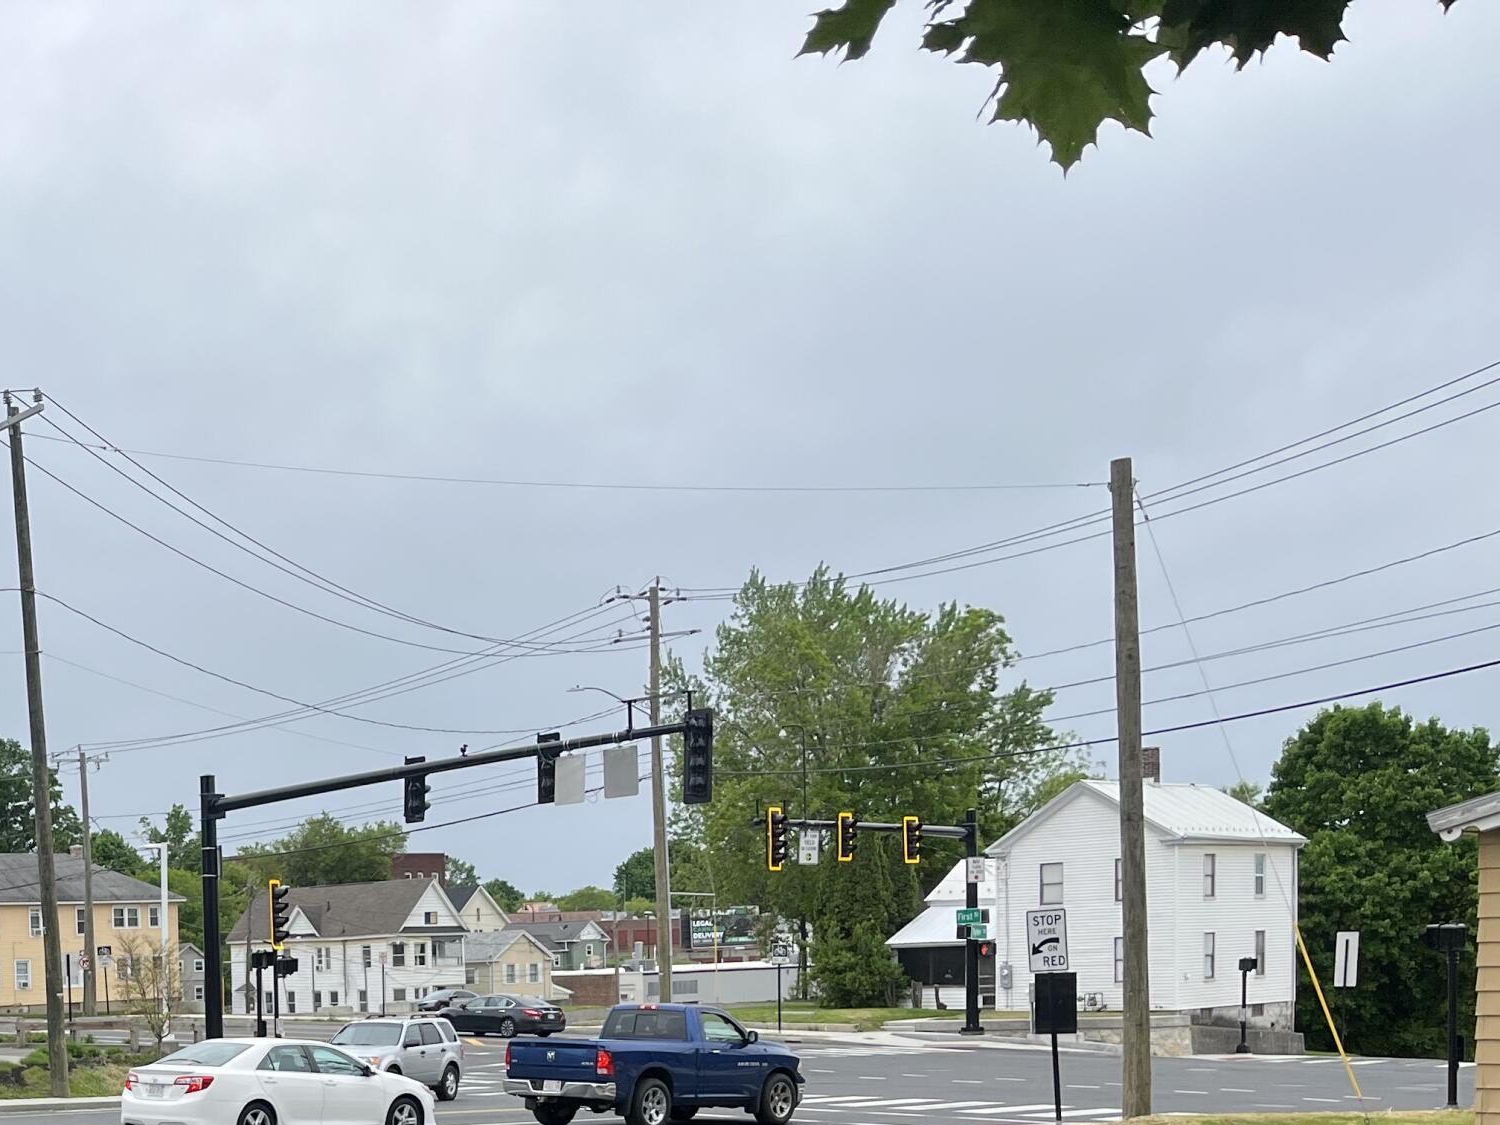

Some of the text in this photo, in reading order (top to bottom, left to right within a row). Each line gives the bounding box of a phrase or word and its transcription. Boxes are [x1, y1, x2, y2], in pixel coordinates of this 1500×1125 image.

[957, 912, 973, 921] First
[1032, 914, 1062, 926] STOP
[1037, 927, 1057, 935] HERE
[1043, 955, 1066, 967] RED
